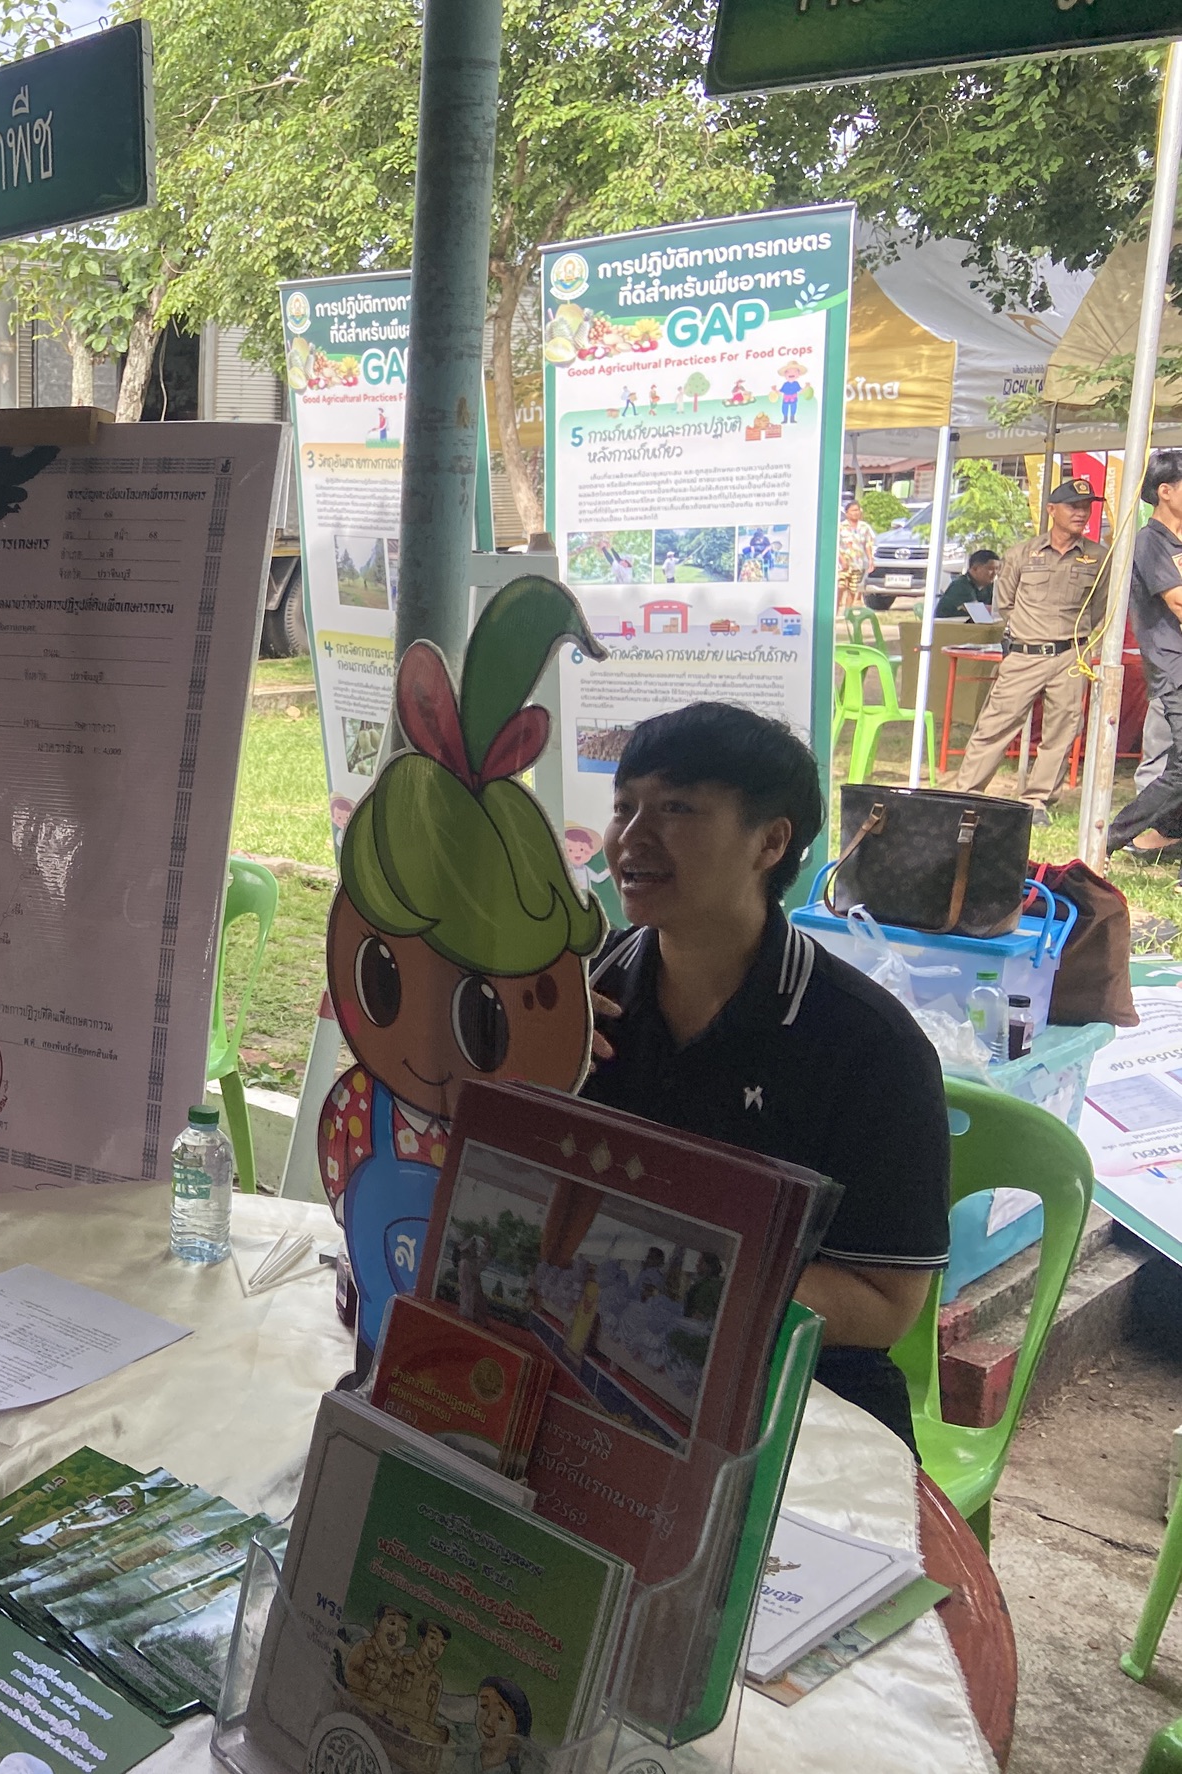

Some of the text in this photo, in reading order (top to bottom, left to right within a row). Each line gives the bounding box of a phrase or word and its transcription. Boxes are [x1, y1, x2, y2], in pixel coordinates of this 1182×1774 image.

[597, 232, 832, 280] การปฏิบัติทางการเกษตร
[618, 267, 806, 307] ที่ดีสำหรับพืชอาหาร
[666, 298, 770, 349] GAP
[362, 348, 409, 386] GA
[568, 345, 812, 378] Good Agricultural Practices For Food Crops
[303, 395, 320, 404] Good
[321, 394, 362, 406] Agricultural
[363, 394, 398, 402] Practices
[570, 415, 742, 447] 5 การเก็บเกี่ยวและการปฏิบัติ
[307, 451, 316, 468] 3
[587, 443, 683, 463] หลังการเก็บเกี่ยว
[324, 640, 333, 658] 4
[571, 647, 584, 665] 6
[667, 642, 723, 663] การขนย้าย
[726, 645, 797, 664] และเก็บรักษา
[387, 1382, 452, 1423] เพื่อเกษตรกรรม
[390, 1366, 487, 1424] สำนักงานการปฏิรูปที่ดิน
